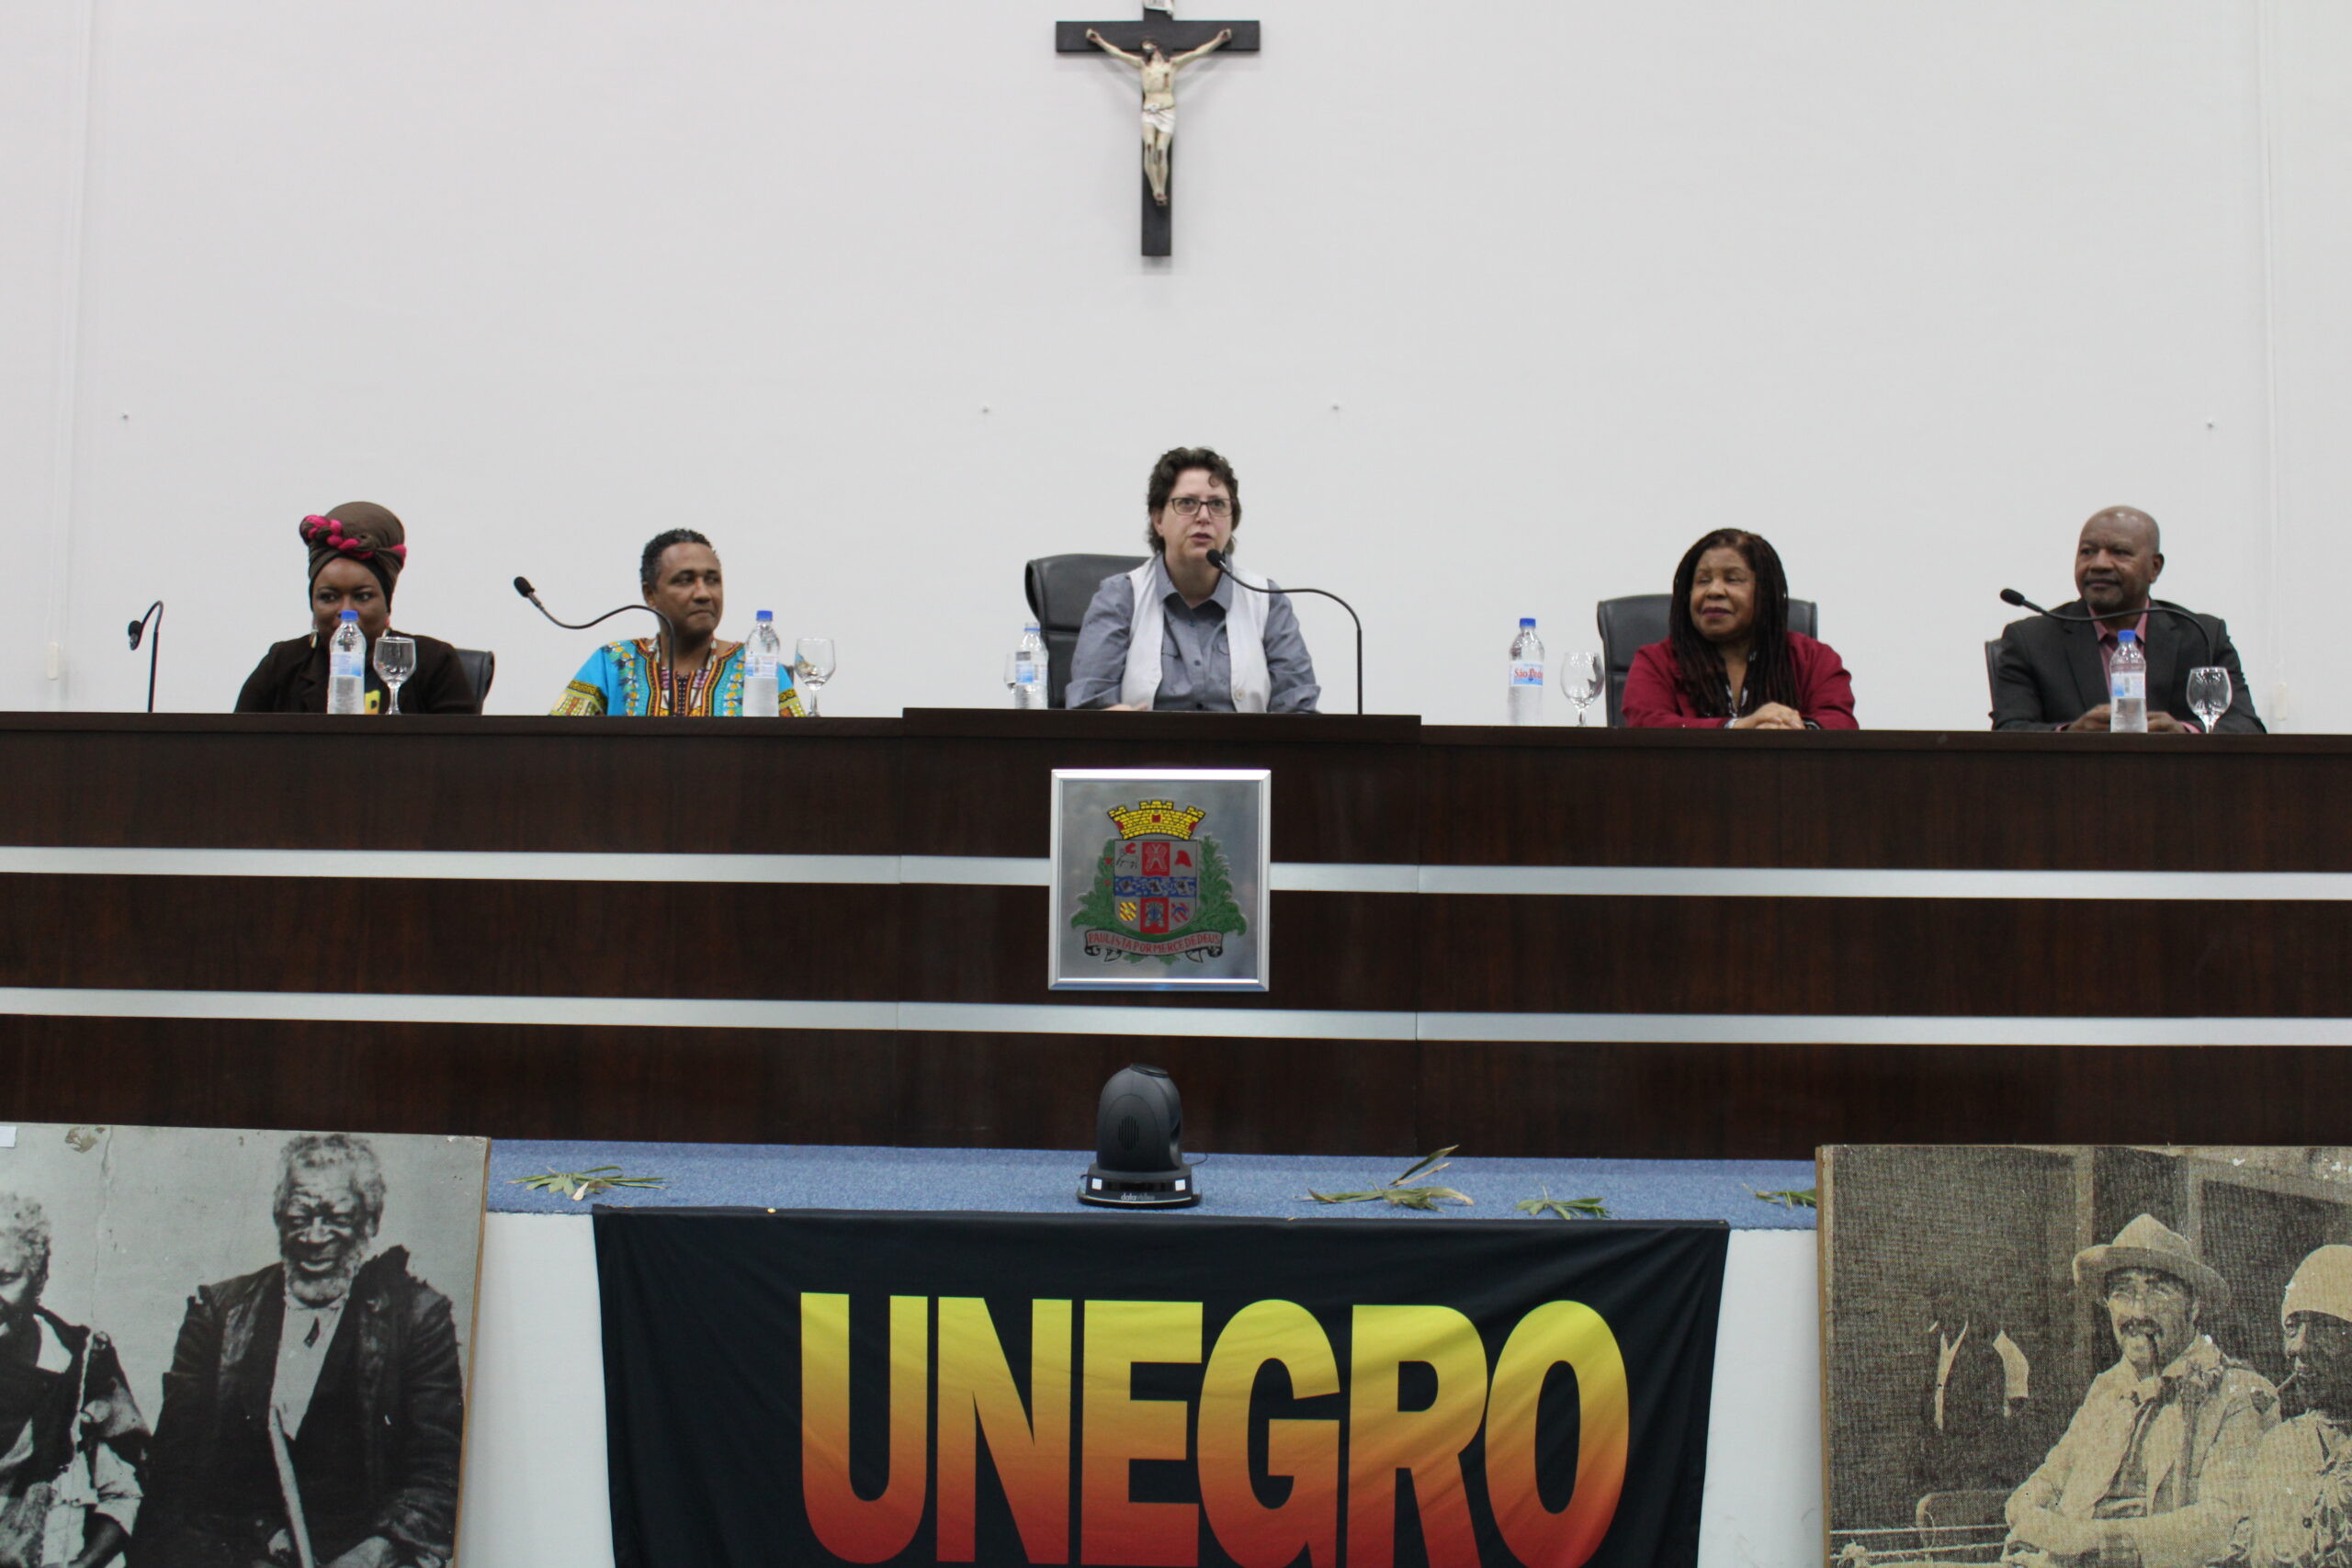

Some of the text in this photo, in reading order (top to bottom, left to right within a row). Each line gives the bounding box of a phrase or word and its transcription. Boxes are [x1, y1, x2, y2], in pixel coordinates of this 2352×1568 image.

[1088, 932, 1133, 949] PAULISTA
[1134, 942, 1152, 953] POR
[1185, 937, 1196, 947] DE
[1197, 932, 1221, 944] DEUS
[800, 1292, 1630, 1568] UNEGRO
